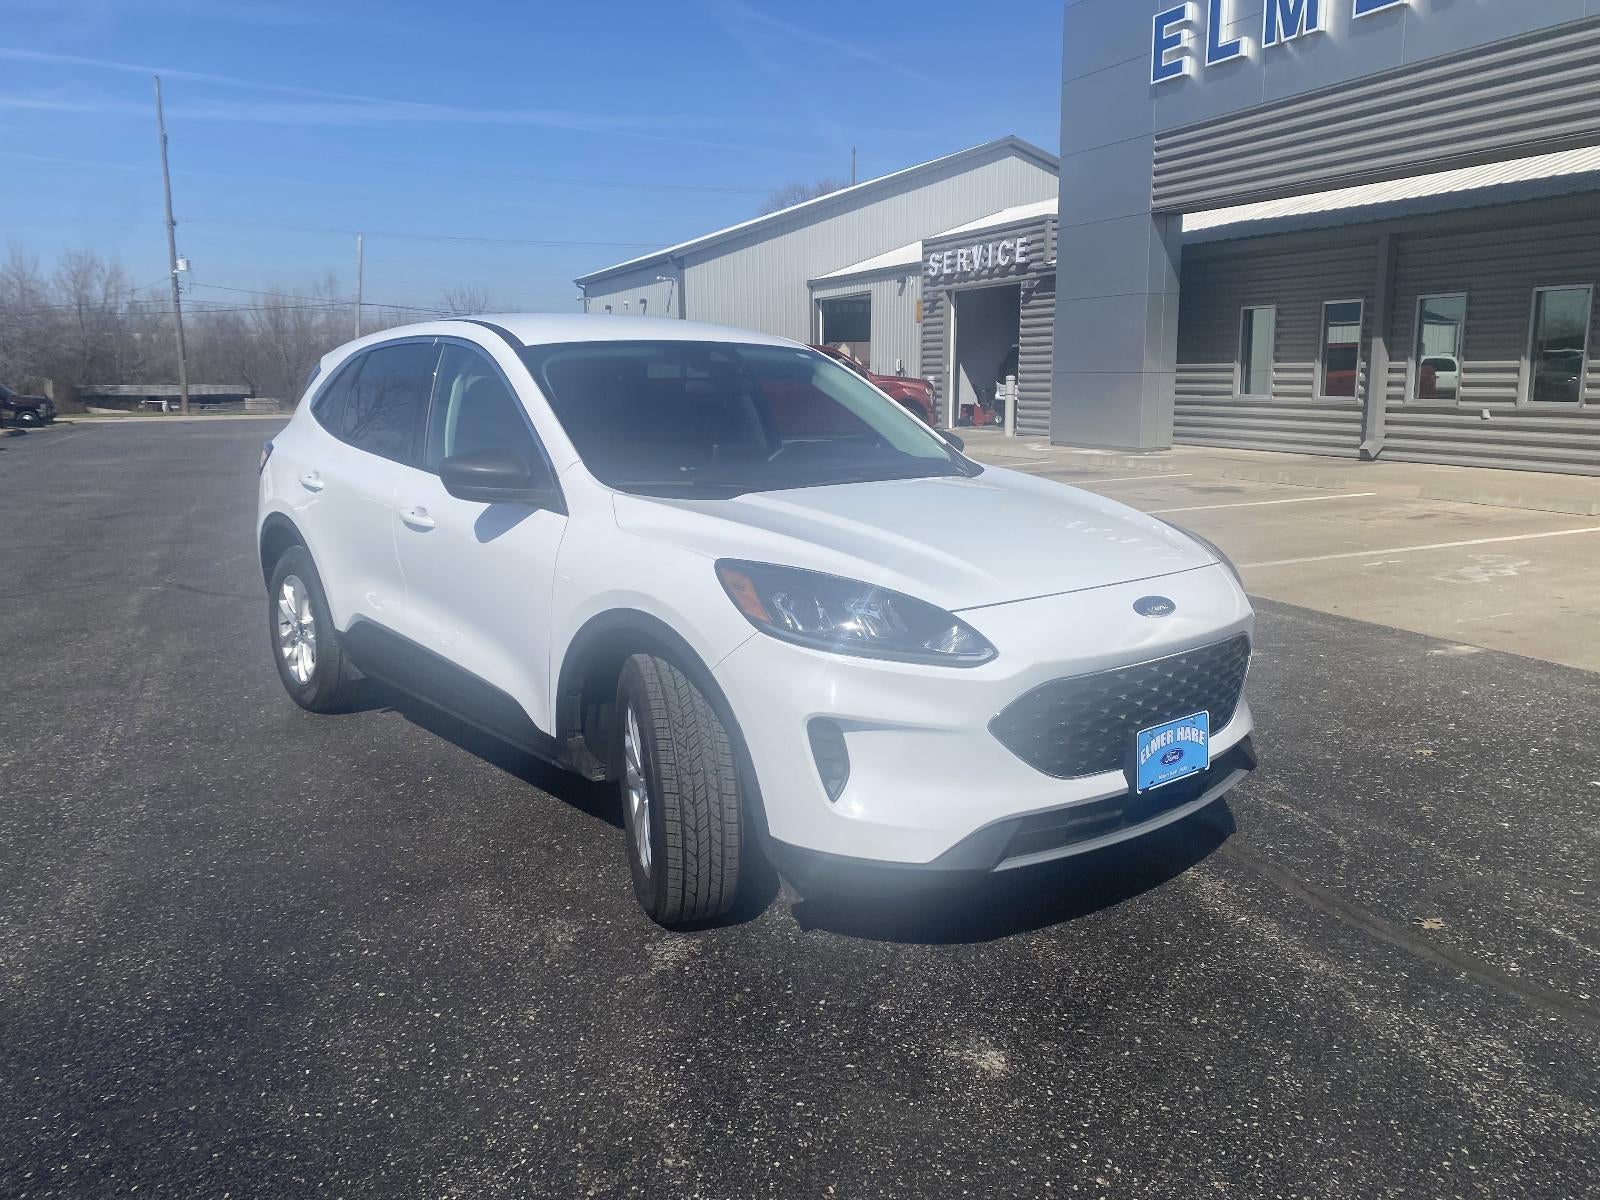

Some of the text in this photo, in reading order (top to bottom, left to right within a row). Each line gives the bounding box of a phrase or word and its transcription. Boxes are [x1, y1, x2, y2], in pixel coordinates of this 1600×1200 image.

[1150, 0, 1410, 84] ELM
[928, 237, 1027, 277] SERVICE
[1140, 730, 1174, 765] ELMER
